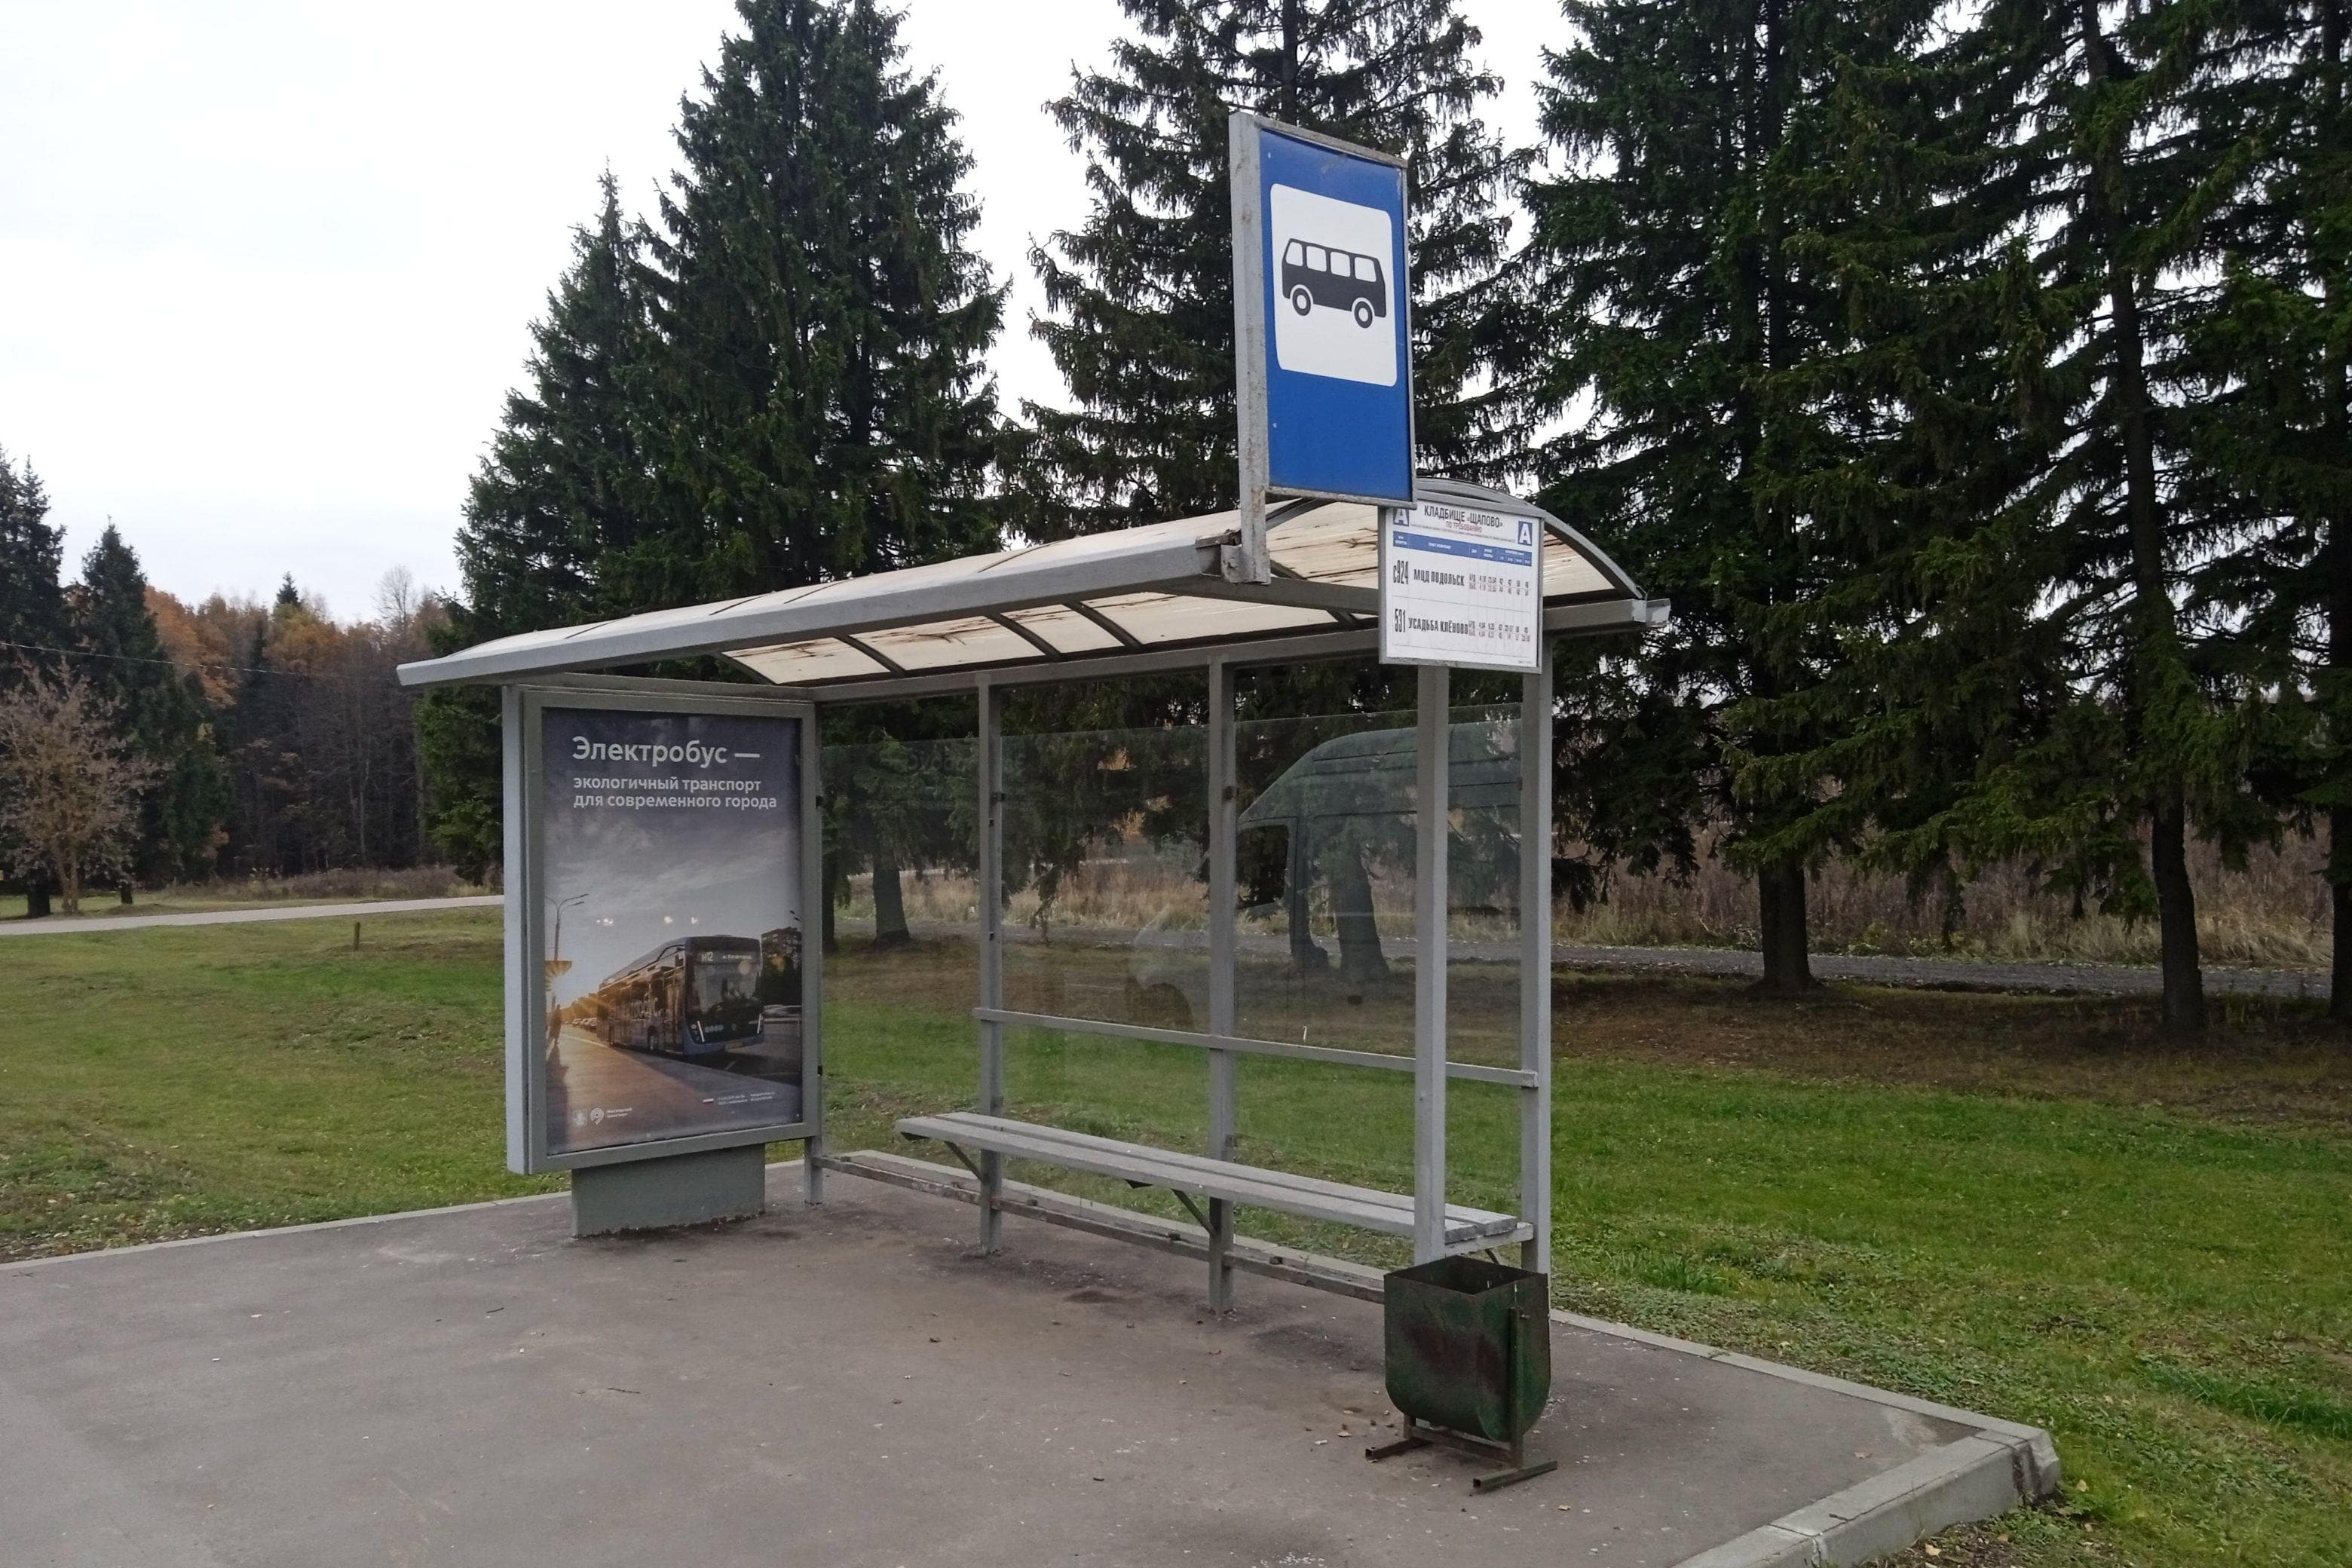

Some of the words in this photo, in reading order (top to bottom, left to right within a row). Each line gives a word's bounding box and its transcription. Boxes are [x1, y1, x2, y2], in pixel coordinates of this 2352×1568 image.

[1424, 505, 1465, 522] КЛАДБИЩЕ
[1466, 513, 1504, 528] «ЩАПОВО»
[1518, 523, 1532, 544] А
[1413, 568, 1429, 583] МЦД
[1431, 571, 1465, 586] ПОДОЛЬСК
[1395, 608, 1406, 632] 531
[1408, 617, 1439, 632] УСАДЬБА
[571, 735, 728, 769] Электробус
[573, 776, 679, 790] экологичный
[681, 779, 761, 793] транспорт
[573, 794, 604, 808] для
[608, 795, 721, 810] современного
[725, 796, 777, 810] города
